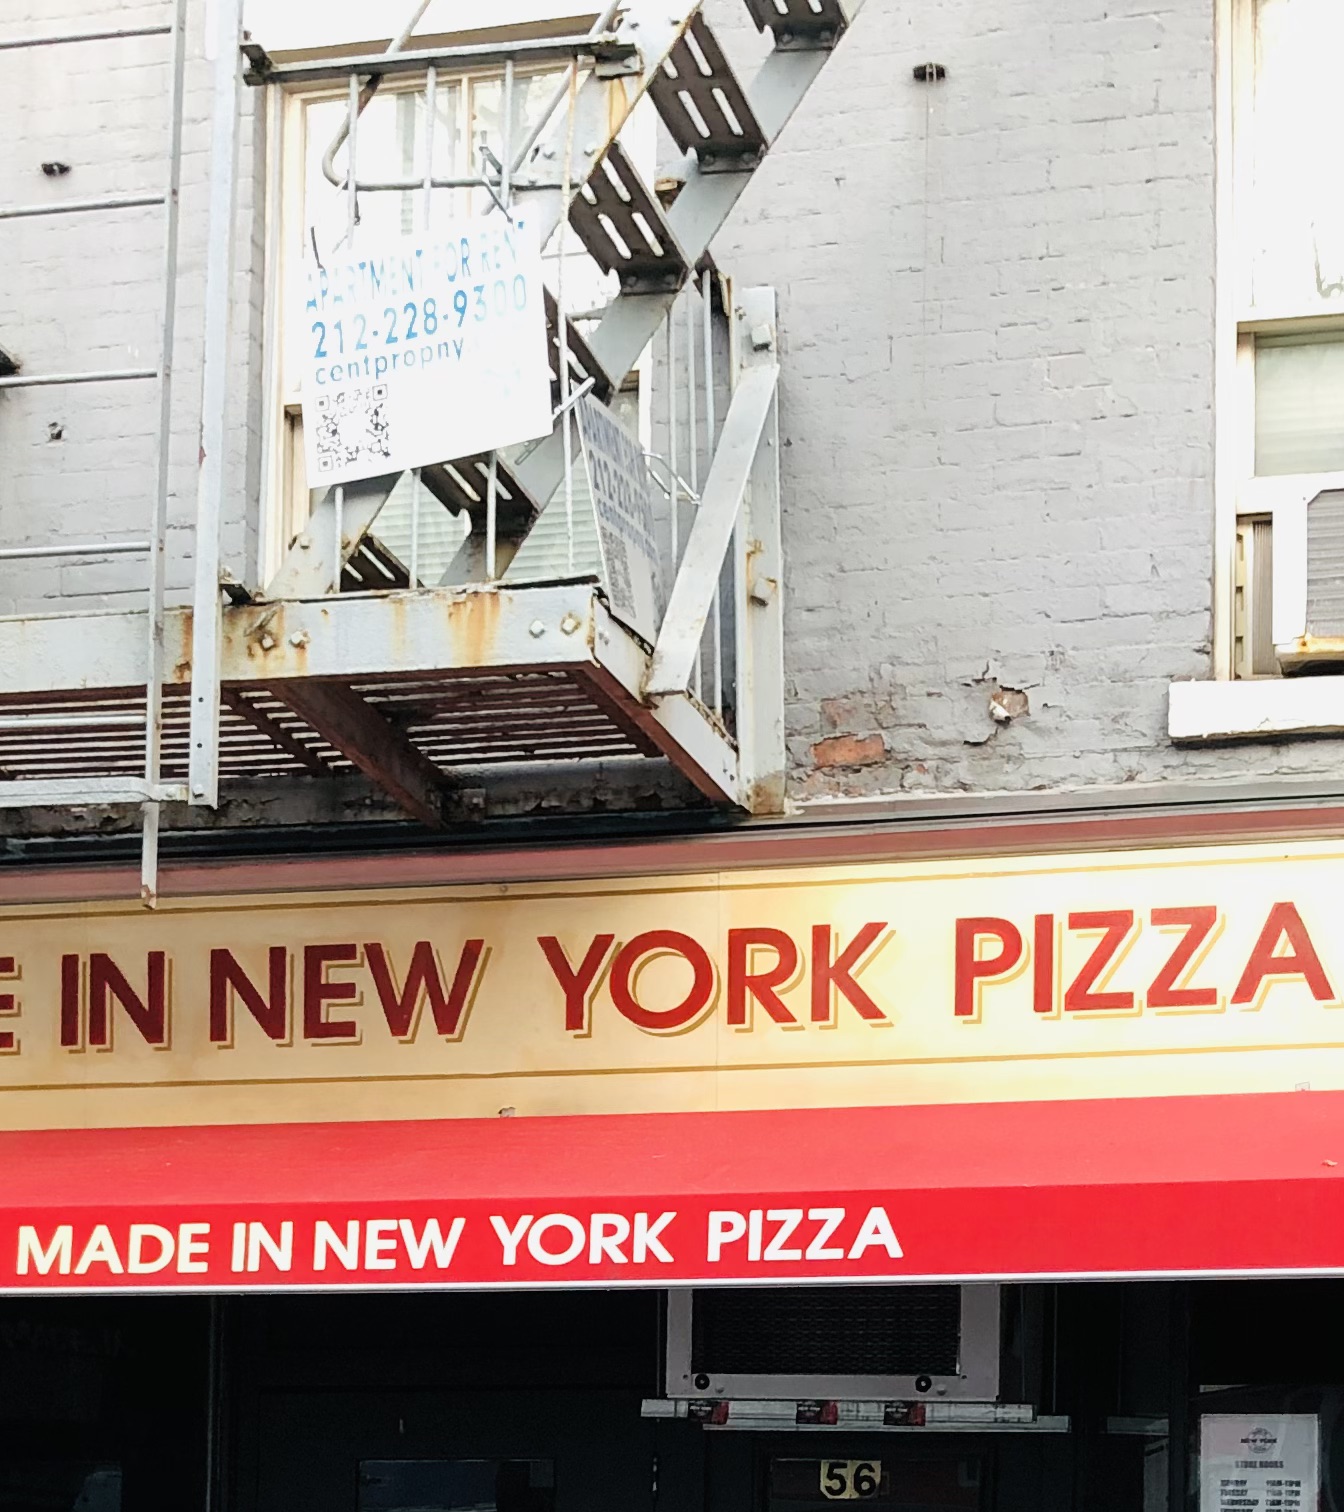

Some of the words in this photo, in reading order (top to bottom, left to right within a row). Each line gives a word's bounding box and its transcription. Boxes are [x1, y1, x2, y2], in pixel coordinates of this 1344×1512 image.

[59, 950, 171, 1053] IN
[208, 938, 488, 1046] NEW
[537, 921, 893, 1036] YORK
[954, 901, 1341, 1020] PIZZA
[15, 1222, 211, 1276] MADE
[231, 1220, 294, 1273] IN
[312, 1217, 466, 1271] NEW
[489, 1211, 678, 1266] YORK
[706, 1206, 904, 1263] PIZZA
[824, 1462, 877, 1497] 56
